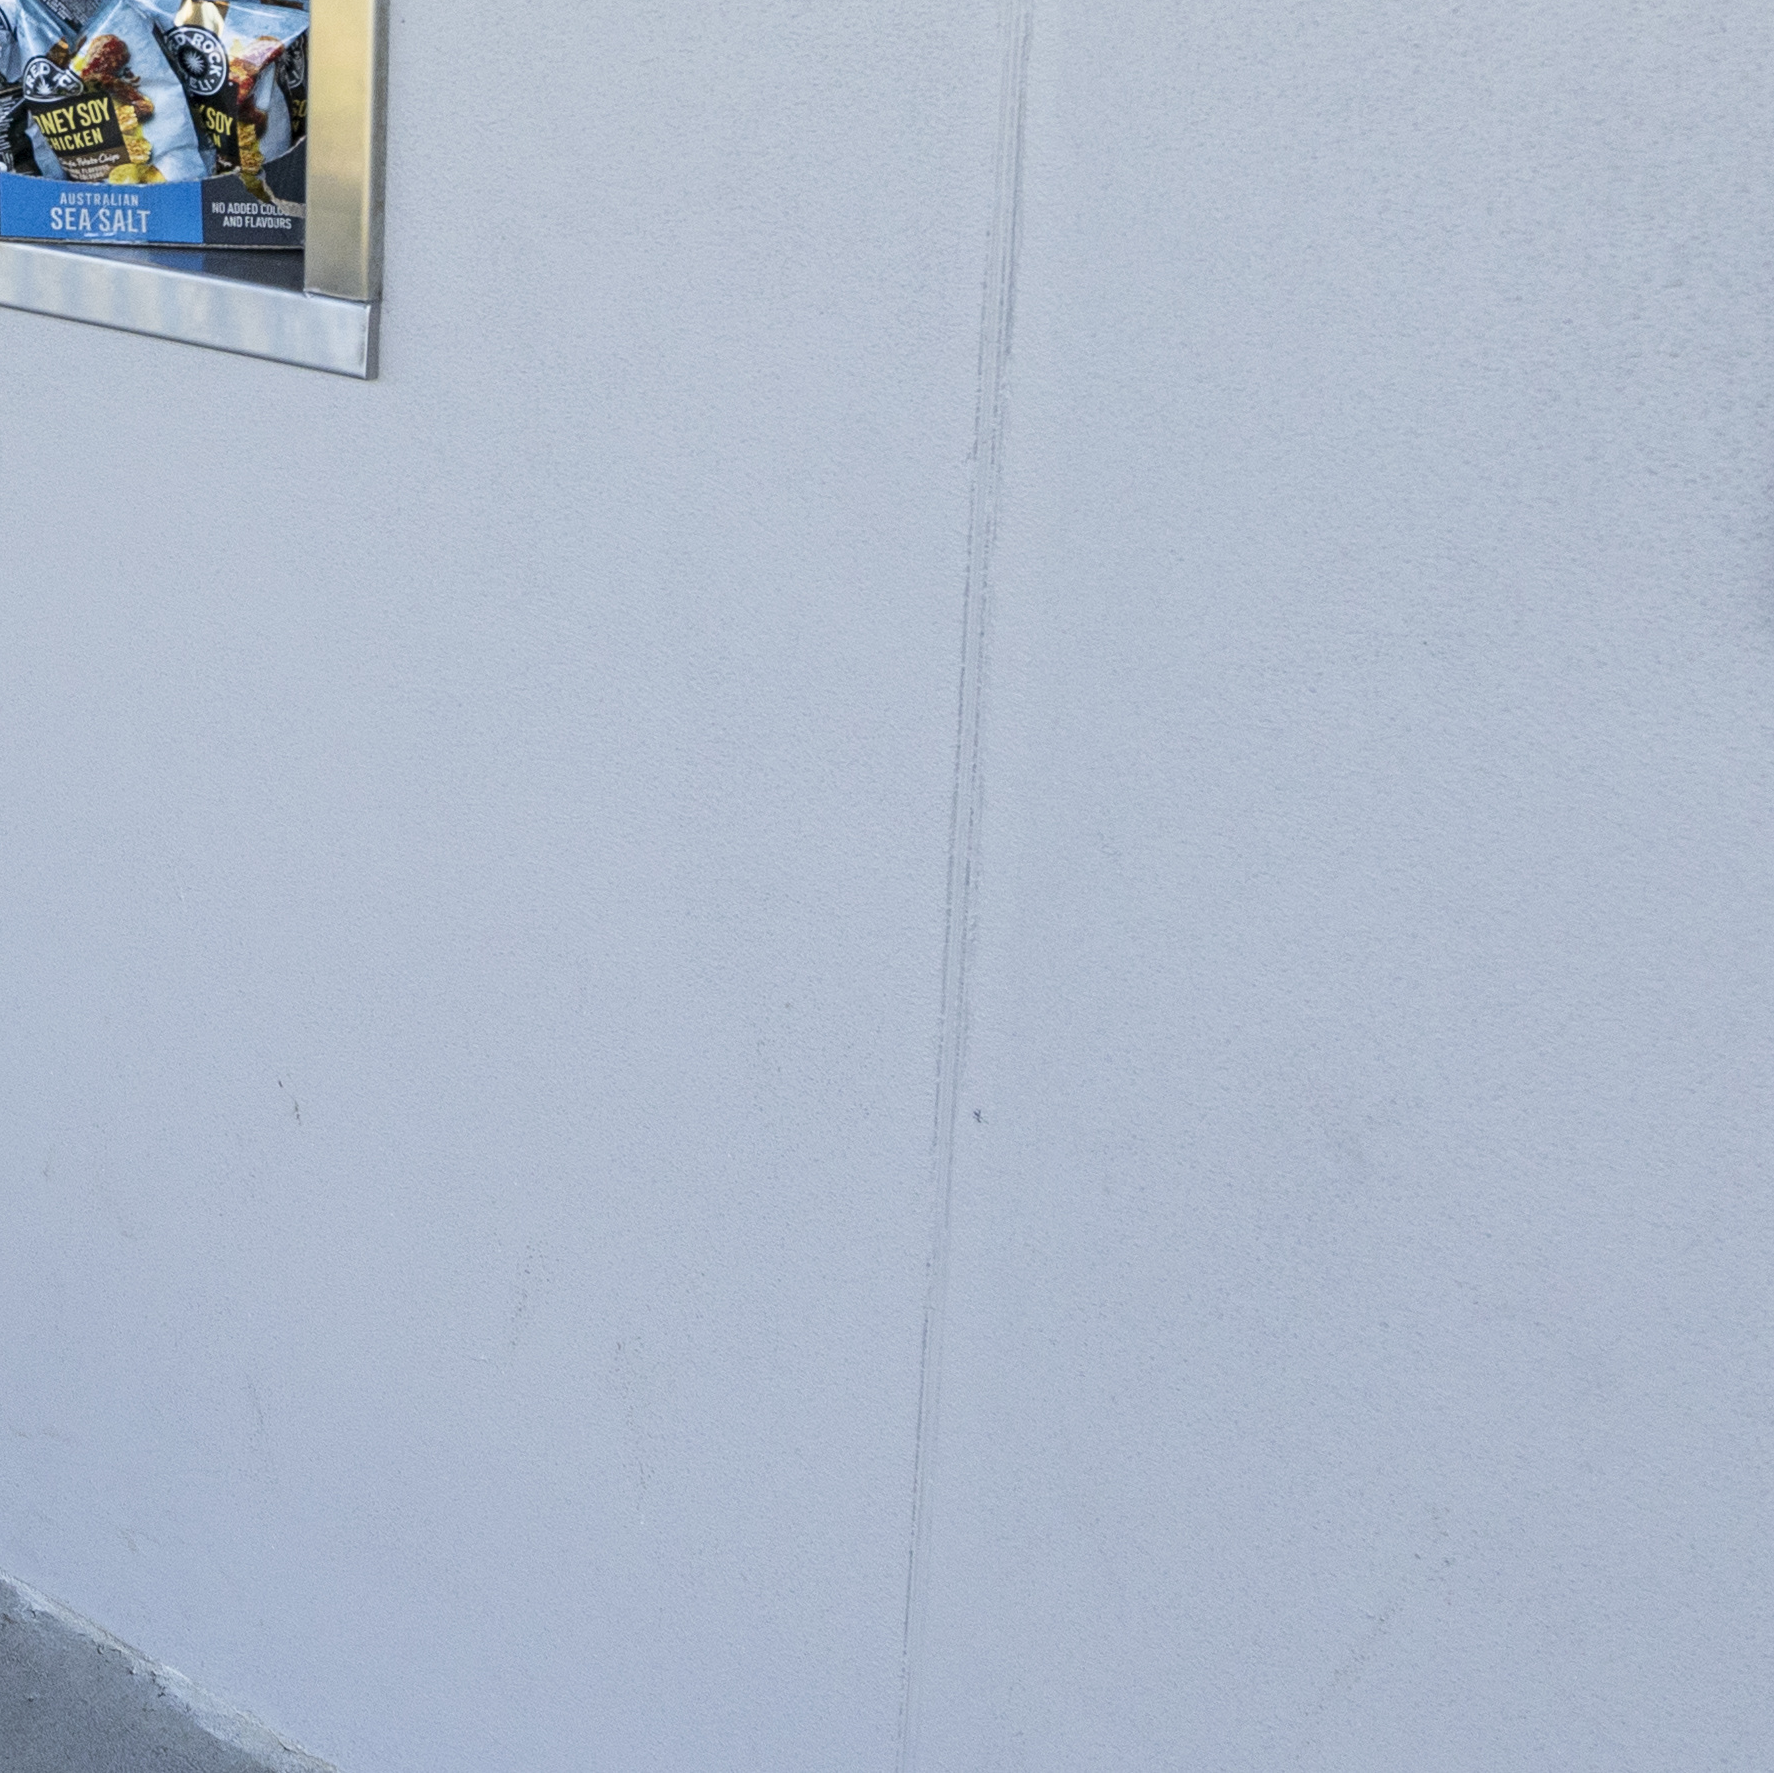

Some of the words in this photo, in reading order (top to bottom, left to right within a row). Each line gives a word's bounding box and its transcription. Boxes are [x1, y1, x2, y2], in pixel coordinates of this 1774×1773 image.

[191, 33, 221, 77] ROCK
[25, 63, 51, 89] RED
[189, 76, 212, 91] ELI
[76, 97, 111, 126] SOY
[206, 107, 233, 135] SOY
[50, 127, 104, 151] HICKEN
[59, 192, 139, 206] AUSTRALIAN
[212, 202, 225, 213] NO
[227, 202, 258, 214] ADDED
[50, 207, 91, 231] SEA
[98, 209, 151, 233] SALT
[223, 215, 243, 227] AND
[245, 217, 292, 230] FLAVOURS
